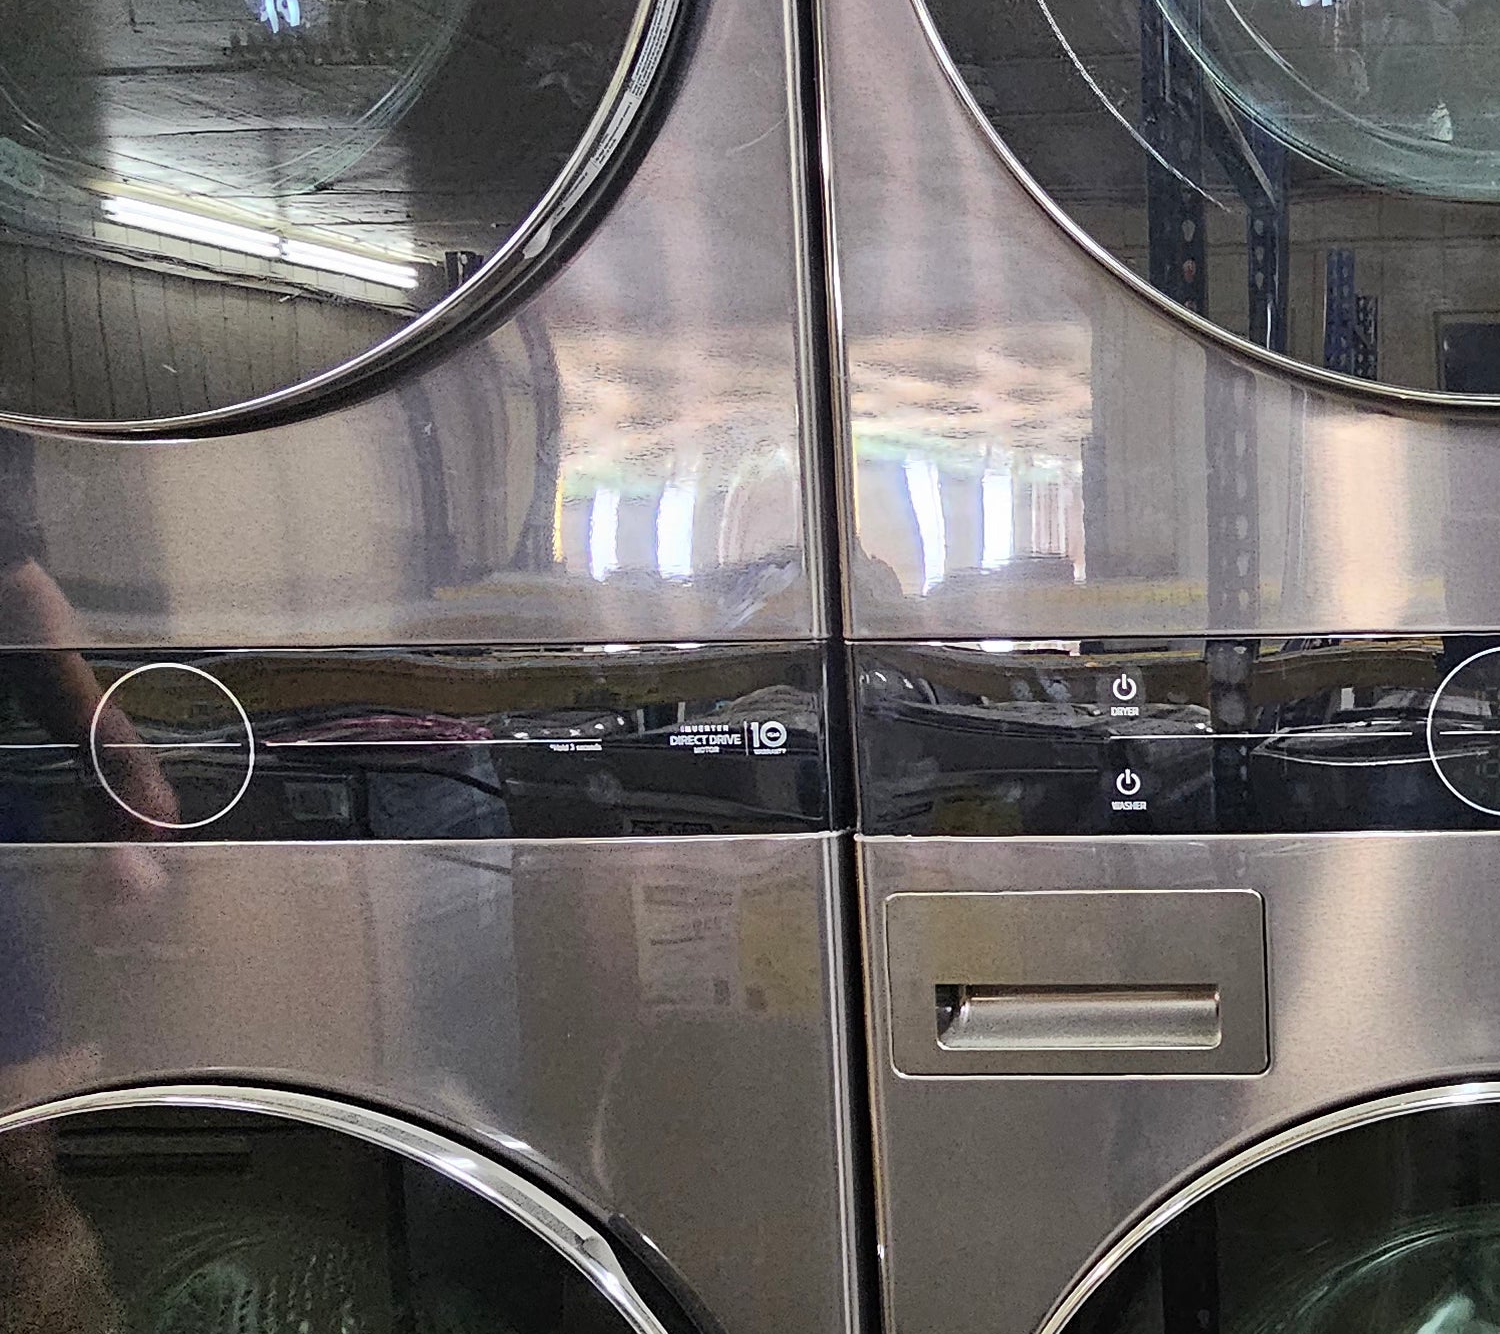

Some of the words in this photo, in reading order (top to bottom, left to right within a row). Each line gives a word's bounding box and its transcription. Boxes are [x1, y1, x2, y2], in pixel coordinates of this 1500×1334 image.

[1110, 706, 1140, 716] DRYER
[750, 720, 787, 747] 10
[669, 735, 708, 745] DIRECT
[709, 734, 742, 744] DRIVE
[693, 746, 720, 754] MOTOR
[1111, 801, 1147, 811] WASHER
